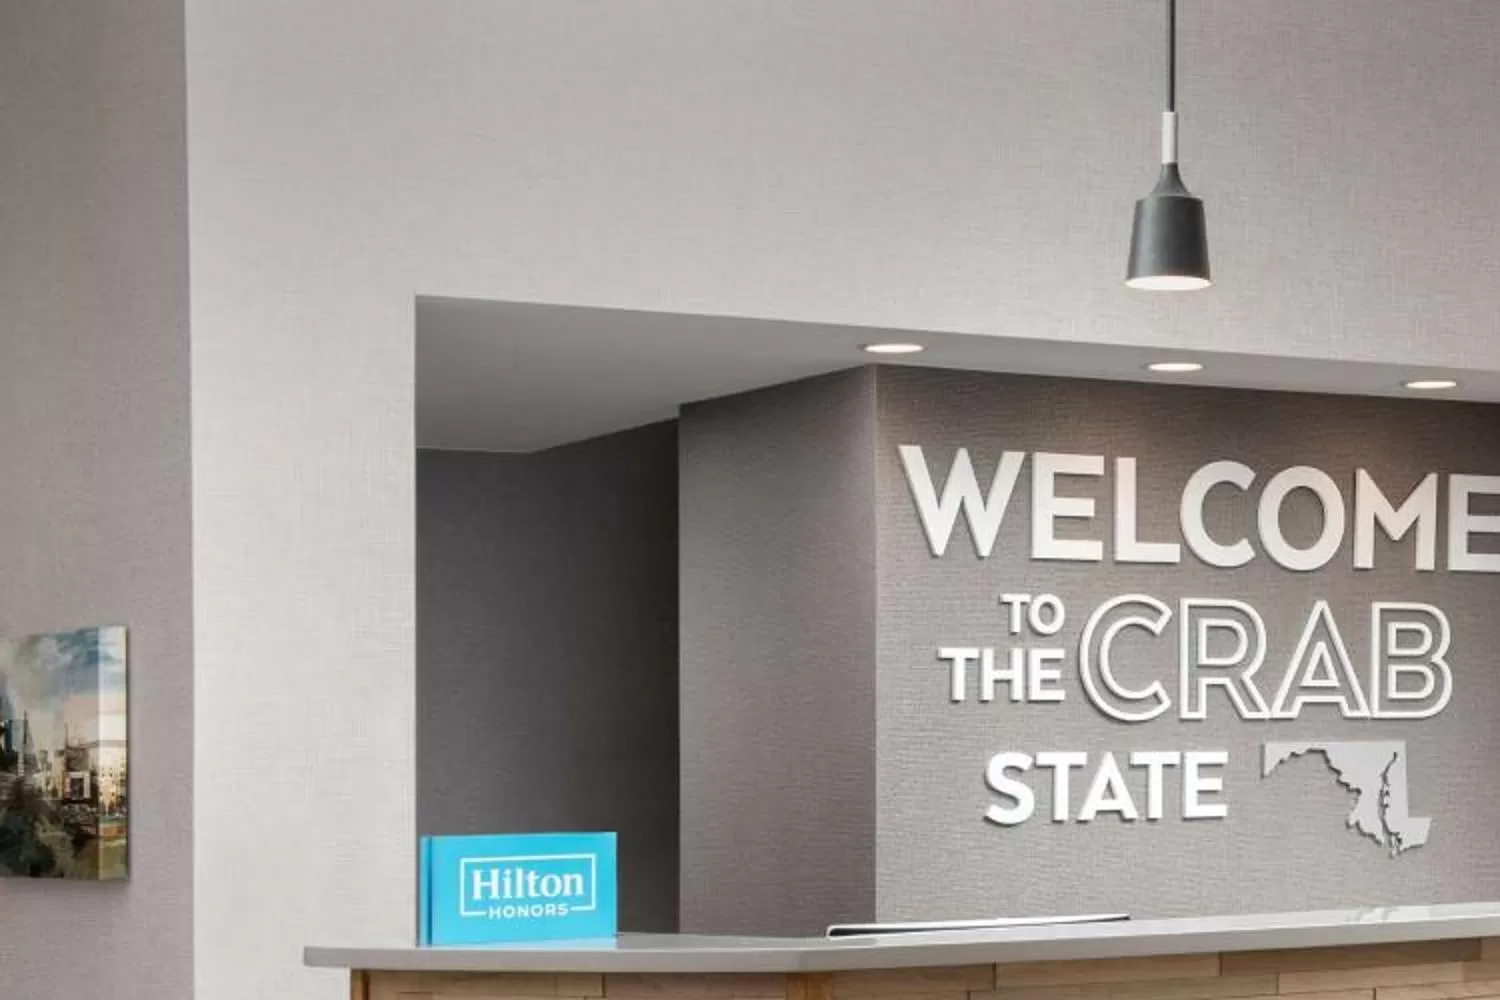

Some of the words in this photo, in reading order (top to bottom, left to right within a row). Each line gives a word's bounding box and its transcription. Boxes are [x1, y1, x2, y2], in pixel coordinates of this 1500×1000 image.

[1000, 592, 1065, 636] TO
[938, 647, 1066, 702] THE
[1078, 593, 1453, 722] CRAB
[983, 750, 1229, 826] STATE
[471, 866, 585, 901] Hilton
[488, 903, 570, 920] HONORS
